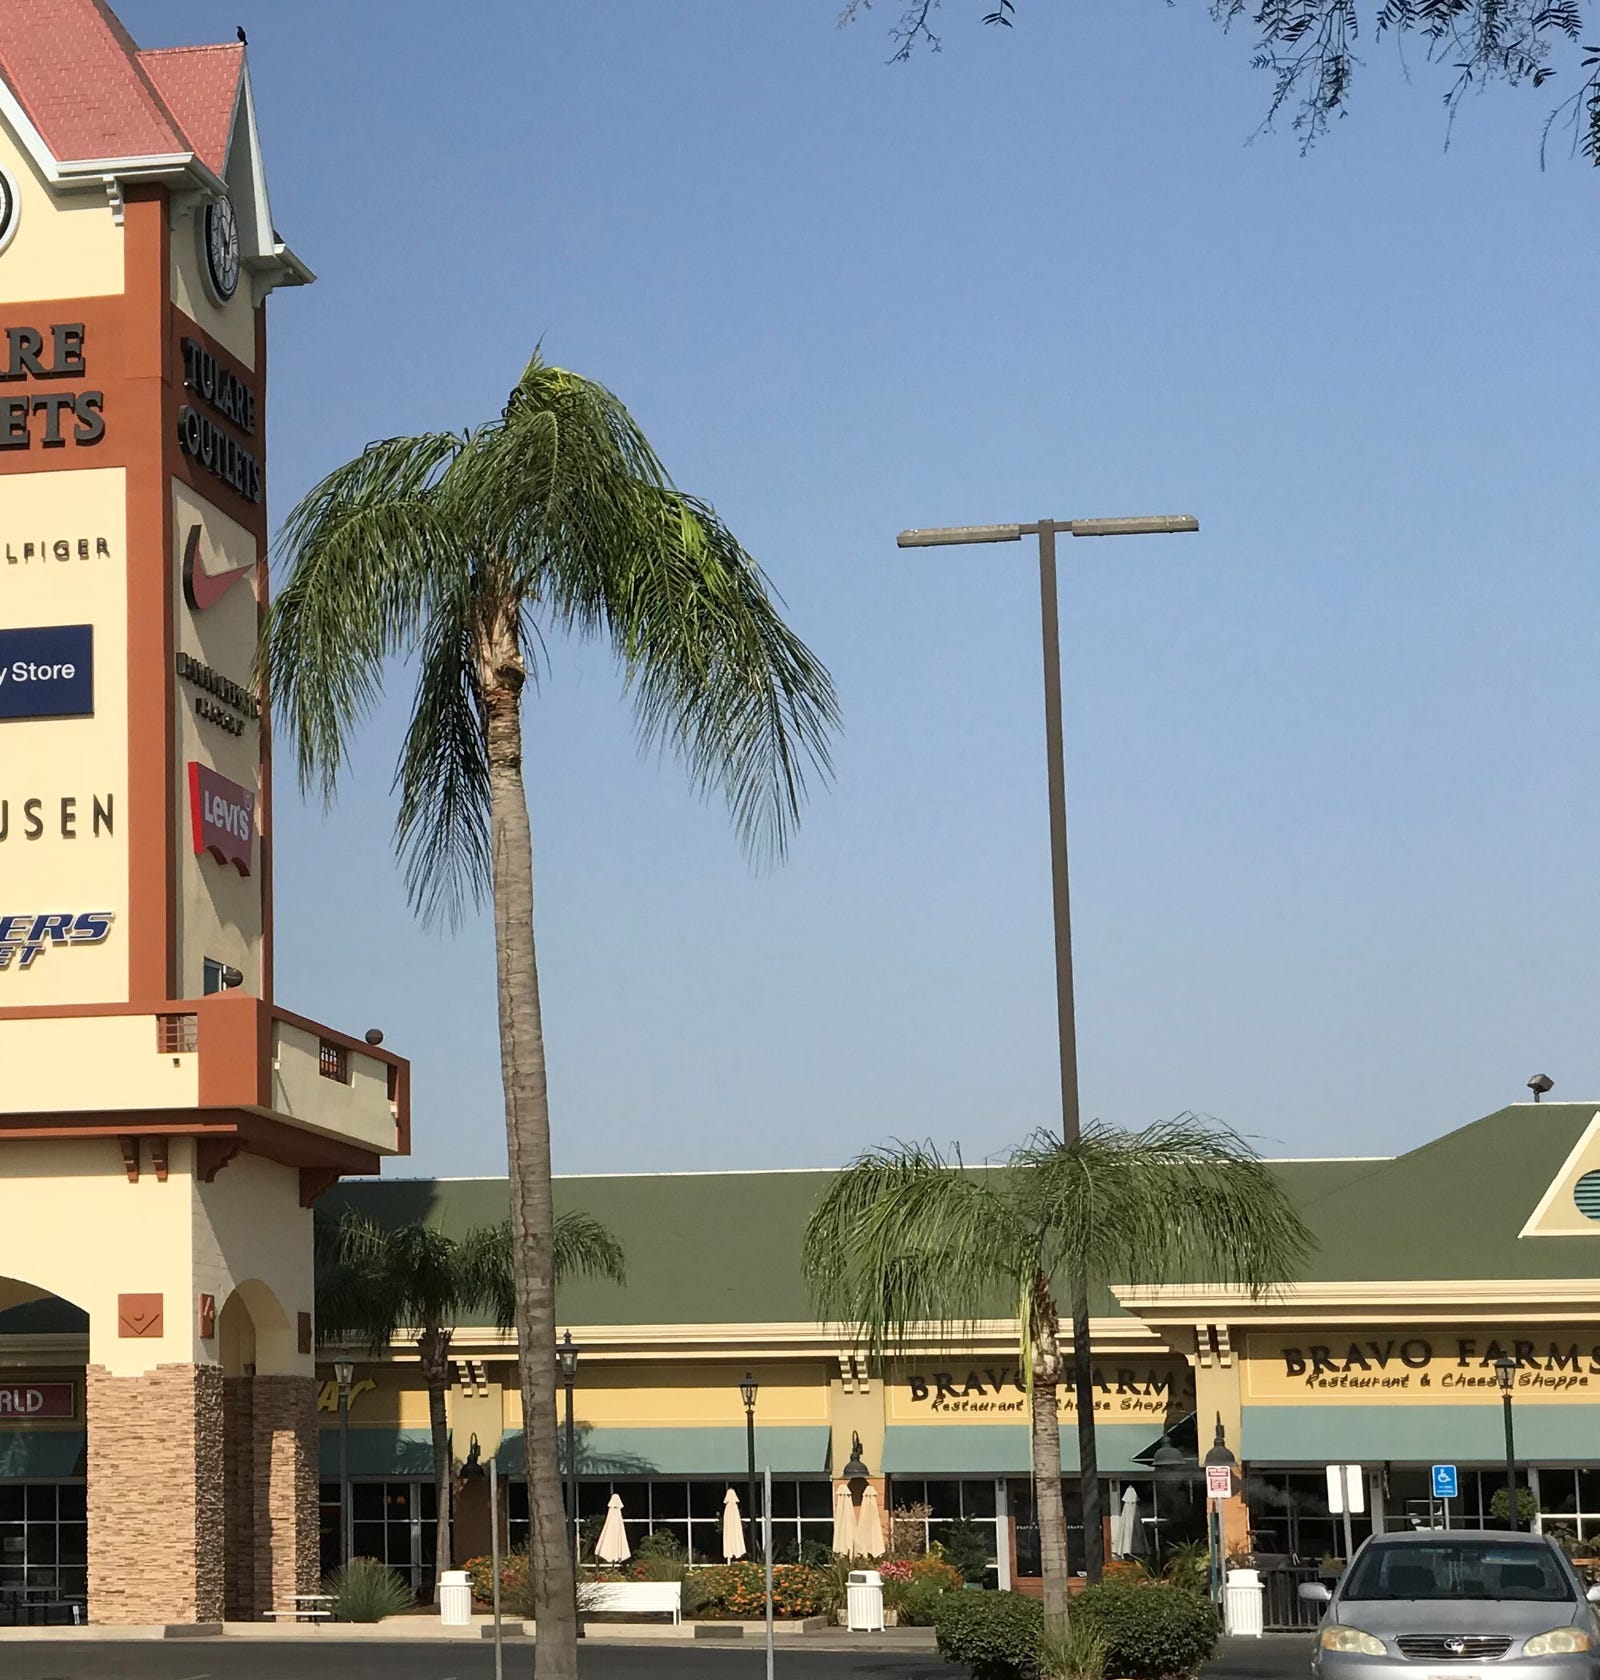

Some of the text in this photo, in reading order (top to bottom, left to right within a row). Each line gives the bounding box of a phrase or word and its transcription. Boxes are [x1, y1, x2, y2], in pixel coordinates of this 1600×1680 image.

[180, 336, 255, 436] TULARE
[178, 404, 261, 503] OUTLETS
[11, 661, 76, 682] Store
[1282, 1338, 1600, 1377] BRAVO FARMS
[1305, 1373, 1410, 1388] Restaurant
[1441, 1373, 1501, 1388] Chees
[1518, 1371, 1589, 1391] Shoppe
[930, 1398, 1024, 1412] Restaurant
[1120, 1397, 1184, 1413] Shoppe
